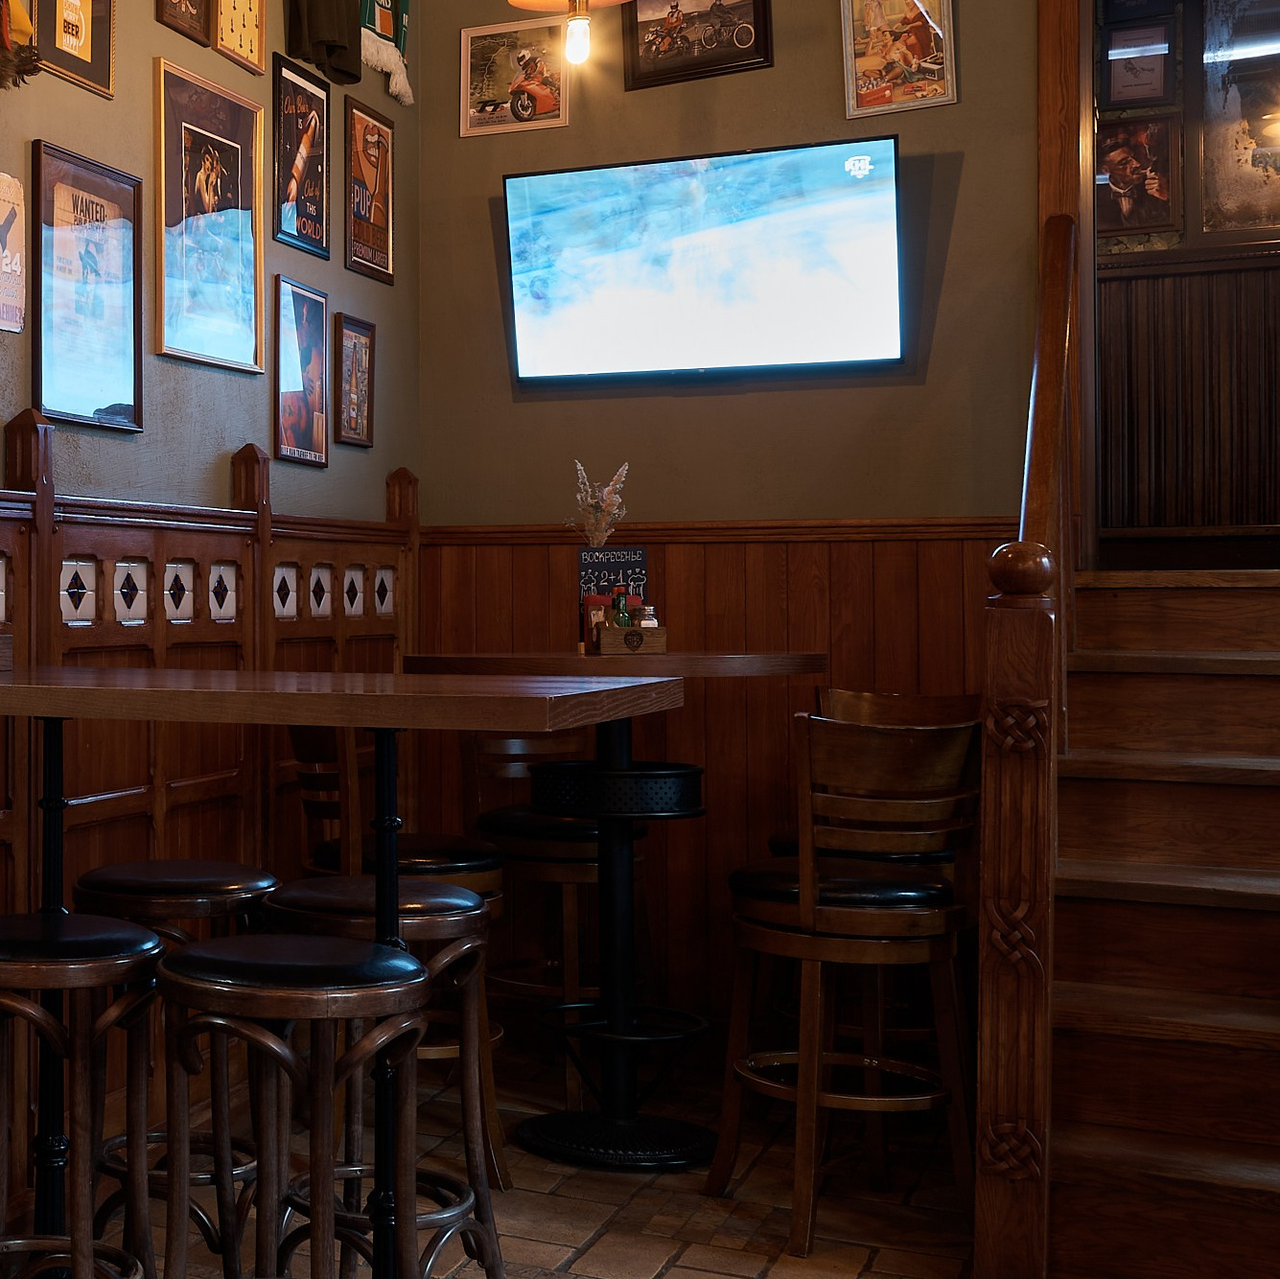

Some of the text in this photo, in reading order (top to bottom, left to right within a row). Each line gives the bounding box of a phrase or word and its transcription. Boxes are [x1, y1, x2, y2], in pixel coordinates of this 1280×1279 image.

[63, 19, 80, 40] BEER
[297, 118, 303, 130] IS
[306, 202, 317, 216] THIS
[353, 241, 373, 261] PREMIUM
[2, 249, 22, 276] 24
[581, 550, 642, 563] ВОСКРЕСЕНЬЕ
[600, 569, 627, 586] 2+1
